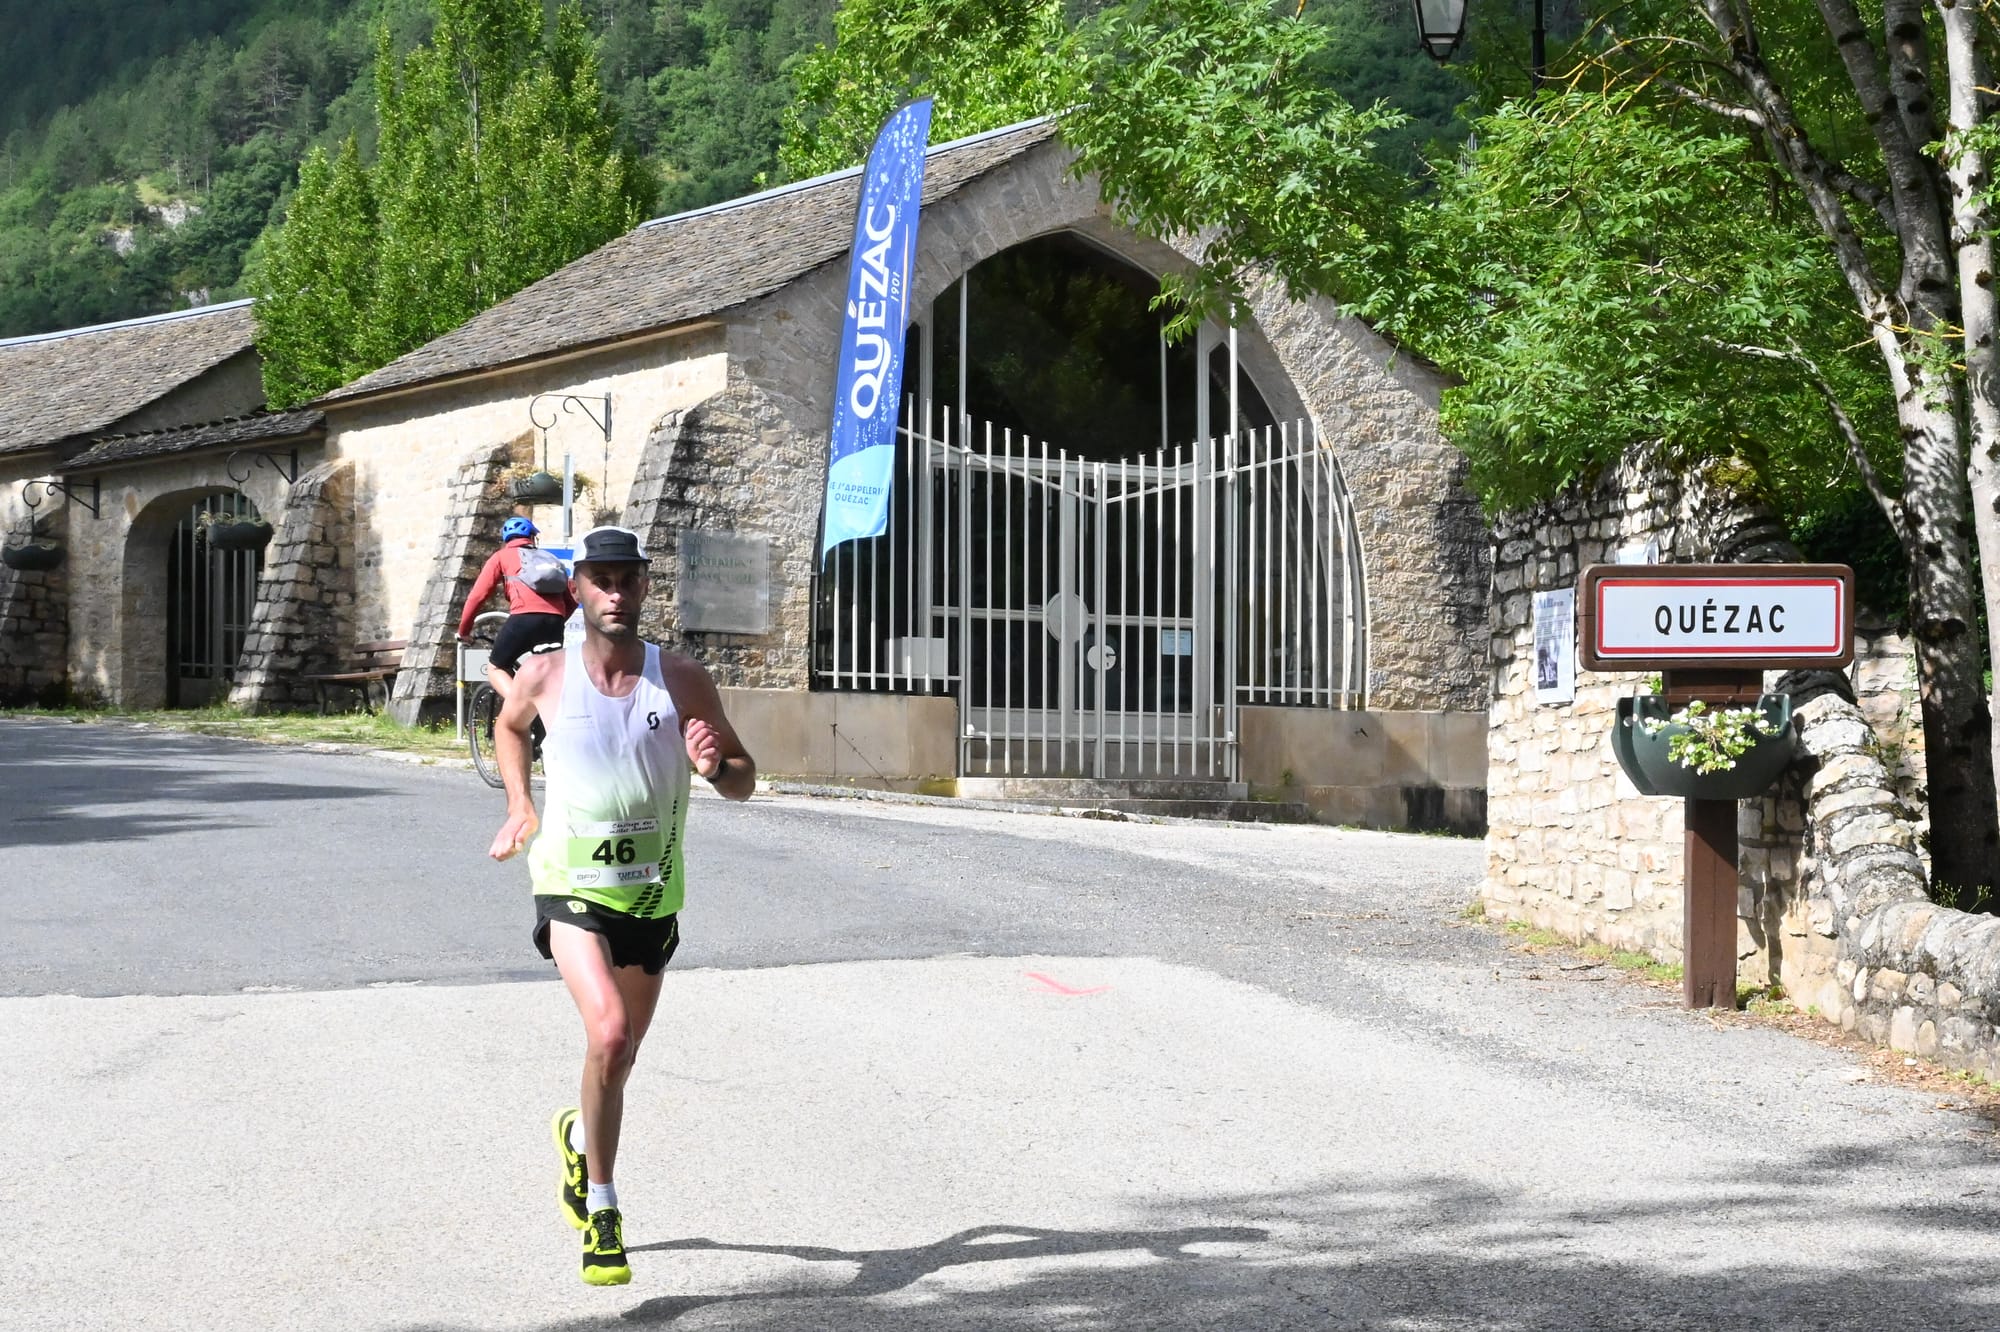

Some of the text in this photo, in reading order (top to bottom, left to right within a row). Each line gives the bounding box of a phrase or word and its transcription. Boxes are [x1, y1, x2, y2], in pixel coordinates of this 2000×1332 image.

[848, 204, 896, 419] QUÉZAC
[1655, 599, 1785, 635] QUÉZAC
[592, 838, 636, 865] 46
